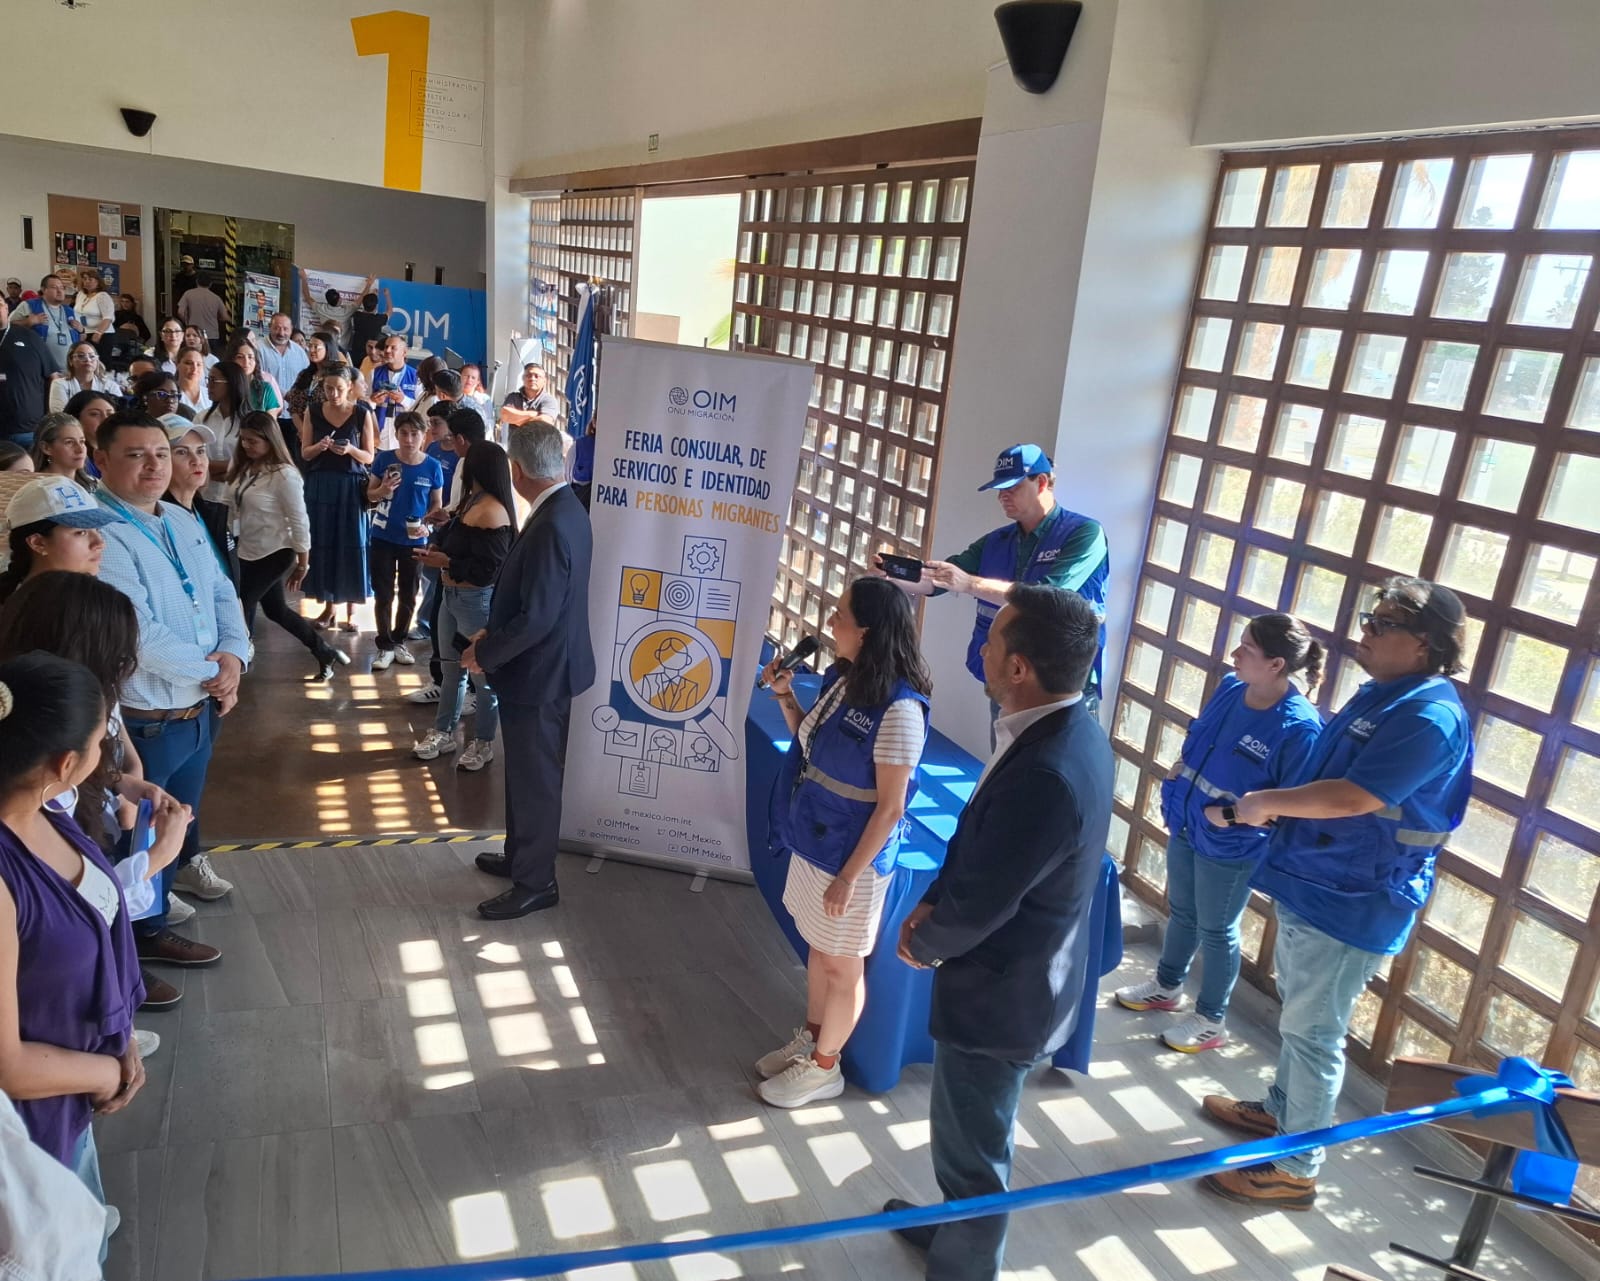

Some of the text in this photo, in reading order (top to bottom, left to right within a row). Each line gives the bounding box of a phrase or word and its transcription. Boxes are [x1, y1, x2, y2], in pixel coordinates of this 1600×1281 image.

[350, 10, 430, 192] 1
[387, 307, 450, 341] OIM
[693, 390, 737, 412] OIM
[667, 406, 735, 423] ONU MIGRACIÓN
[624, 430, 768, 469] FERIA CONSULAR, DE
[612, 457, 771, 500] SERVICIOS E IDENTIDAD
[596, 484, 781, 534] PARA PERSONAS MIGRANTES
[853, 711, 874, 730] OIM
[1251, 739, 1270, 756] OIM
[603, 818, 640, 832] OIMMex
[680, 845, 699, 856] OIM
